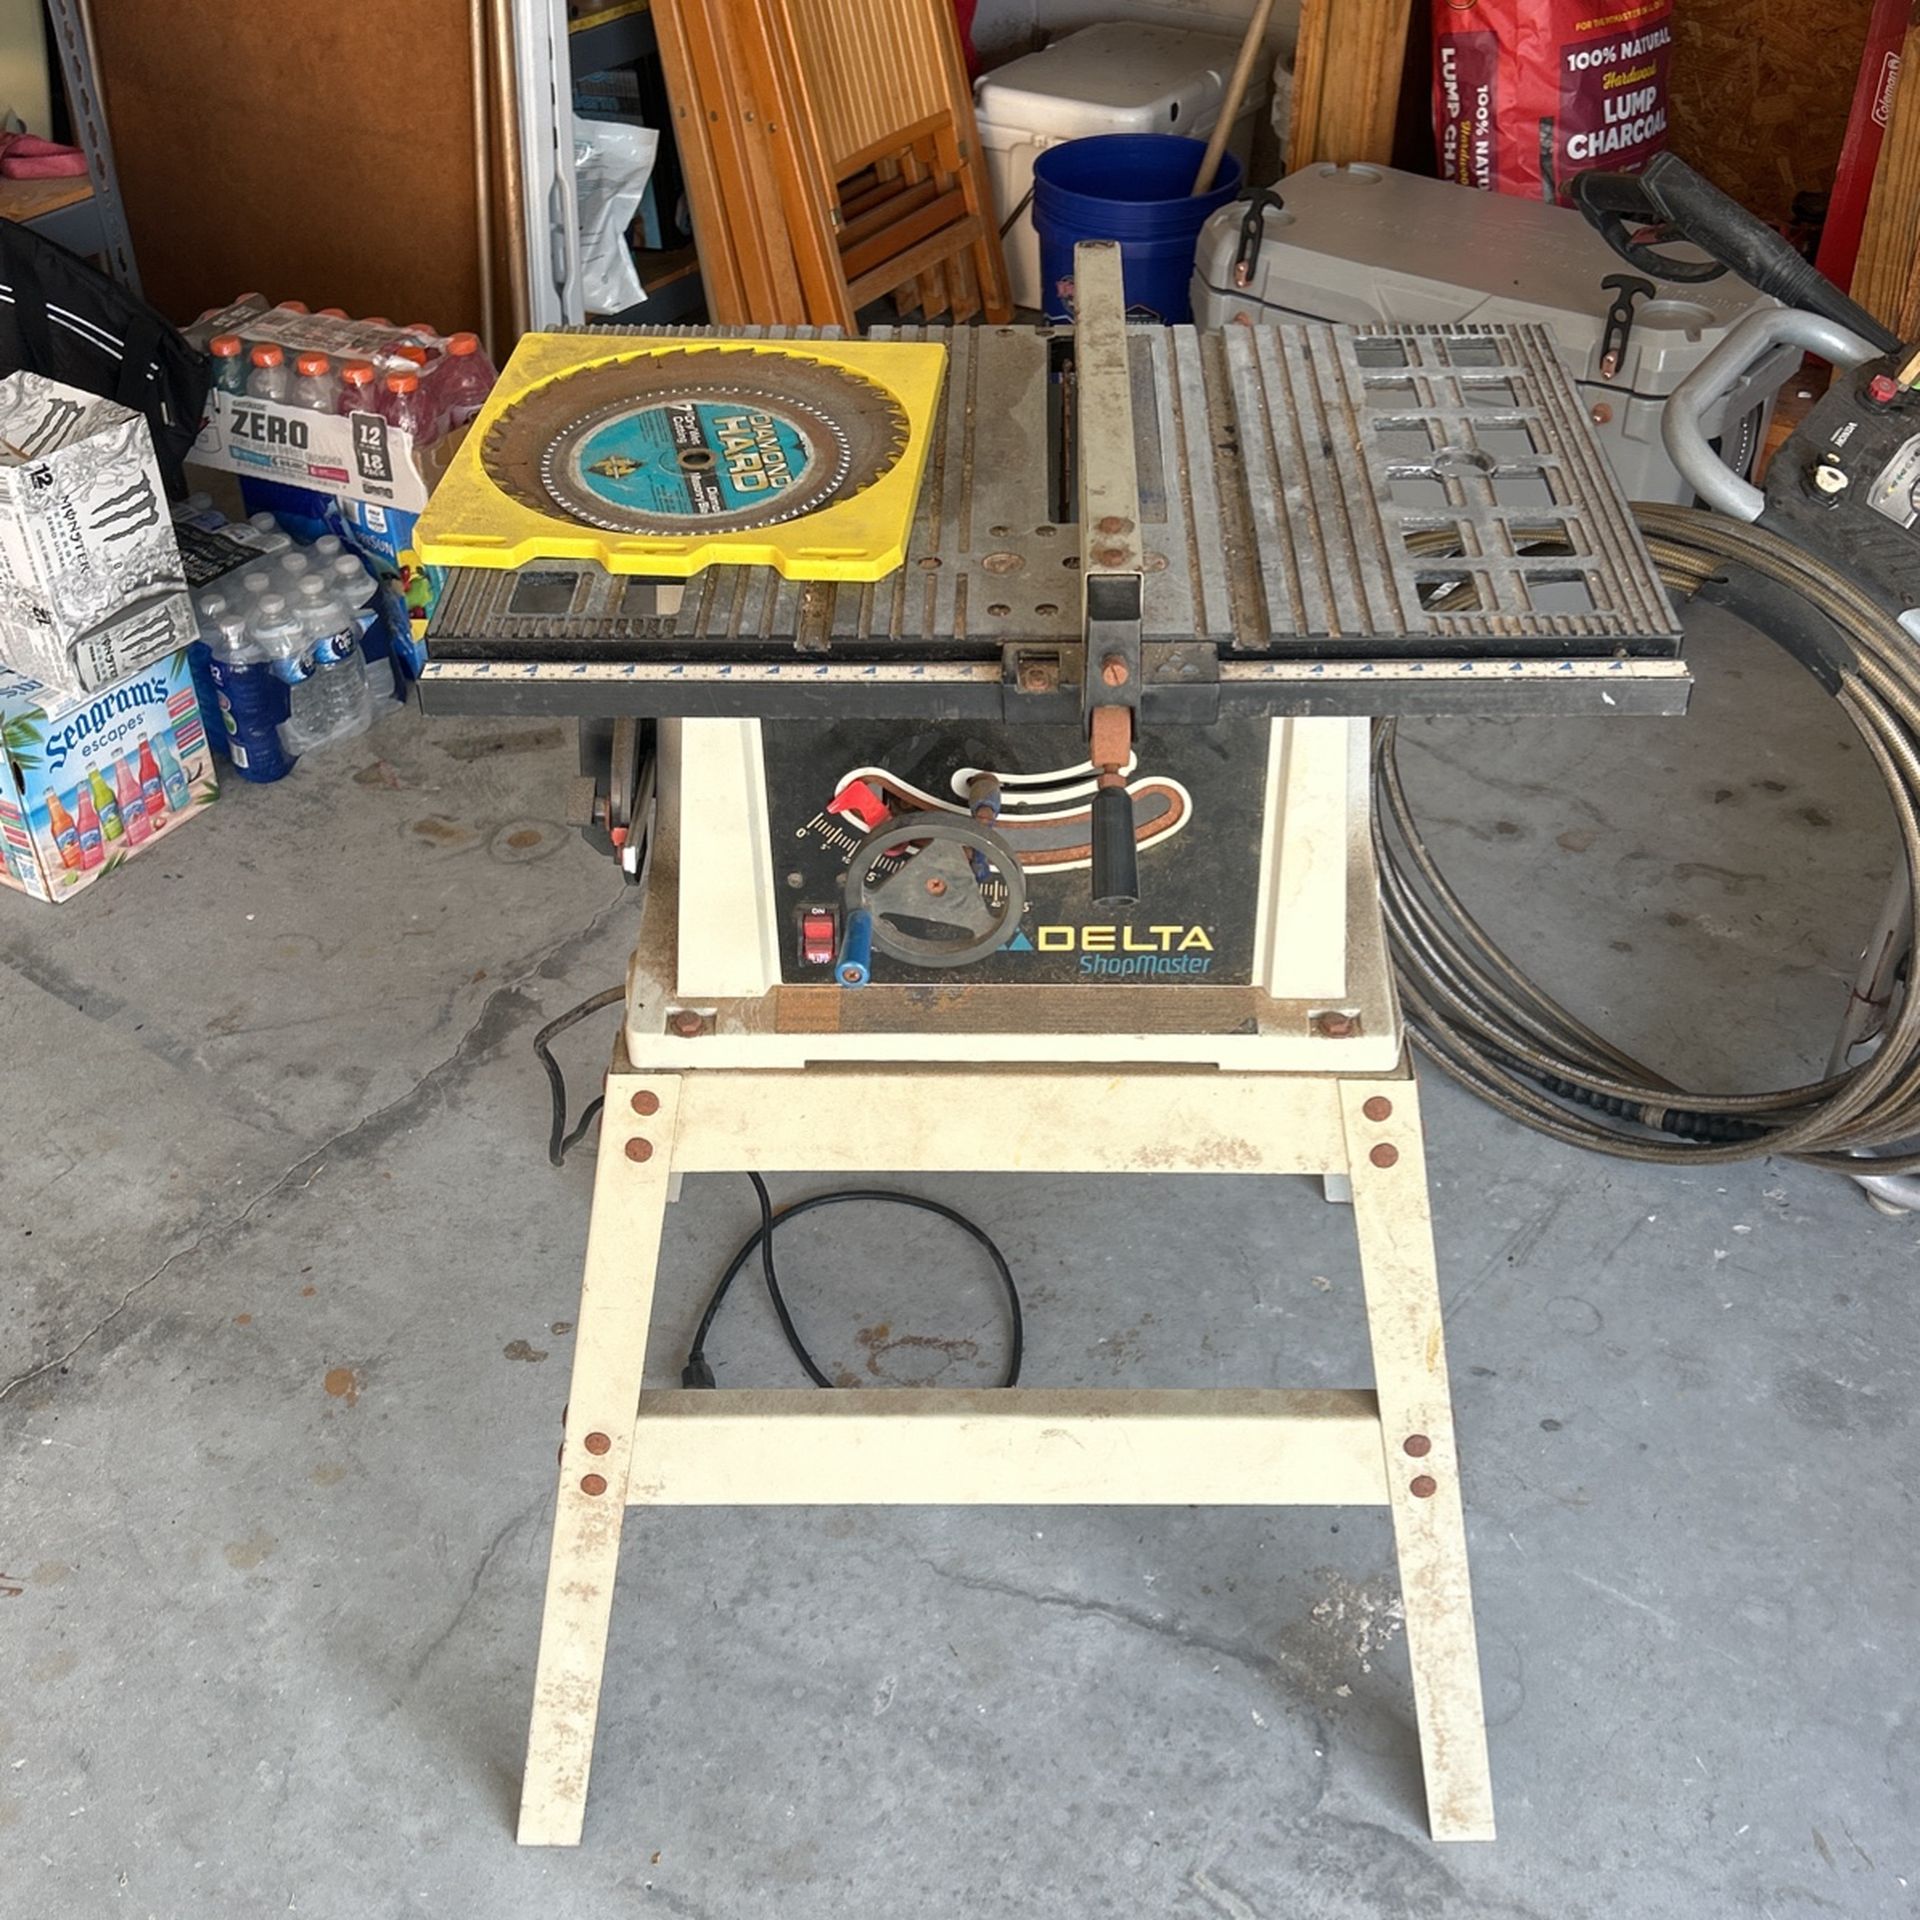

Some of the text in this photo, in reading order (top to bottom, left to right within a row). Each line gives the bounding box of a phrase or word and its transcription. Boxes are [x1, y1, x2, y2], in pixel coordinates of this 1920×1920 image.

[1567, 45, 1617, 71] 100%
[1602, 62, 1657, 90] Hardwood
[1441, 48, 1460, 118] LUMP
[1876, 70, 1898, 120] Coleman
[1475, 85, 1489, 136] 100%
[1604, 86, 1657, 124] LUMP
[1567, 107, 1666, 160] CHARCOAL
[230, 409, 309, 449] ZERO
[359, 425, 381, 446] 12
[361, 452, 384, 470] 18
[714, 415, 768, 493] HARD
[748, 414, 793, 490] DIAMOND
[29, 463, 53, 490] 12
[61, 495, 90, 574] MONSTER
[46, 677, 169, 773] Seagram's
[82, 712, 144, 757] escapes
[1038, 925, 1214, 951] DELTA
[1079, 954, 1212, 976] ShopMaster
